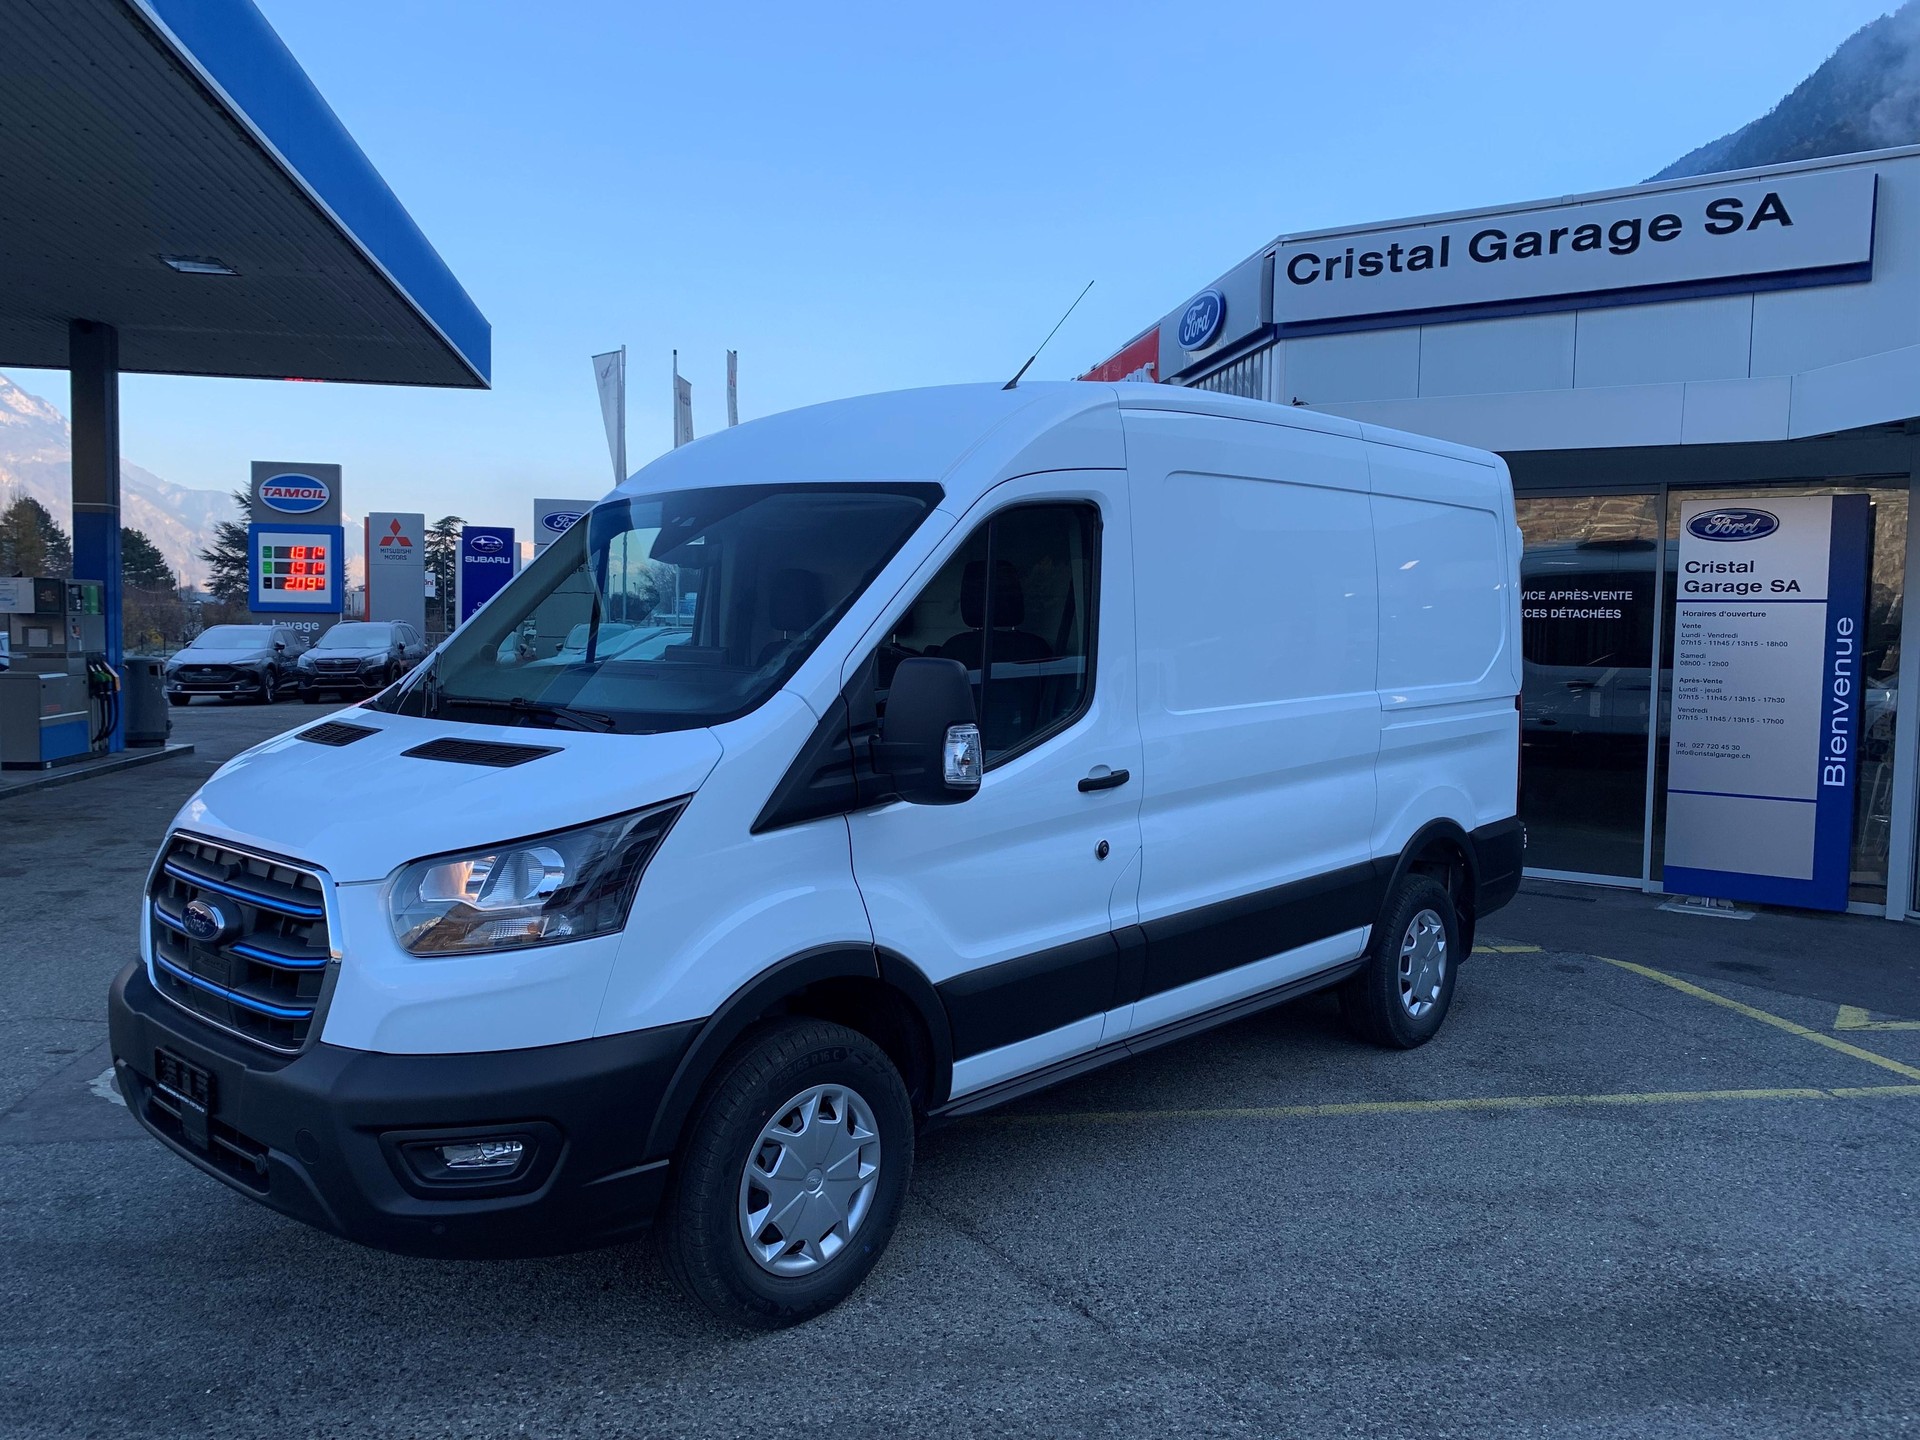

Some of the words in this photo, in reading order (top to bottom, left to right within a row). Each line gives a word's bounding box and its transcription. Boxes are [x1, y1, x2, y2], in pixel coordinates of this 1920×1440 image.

[1286, 235, 1450, 286] Cristal
[1468, 213, 1683, 263] Garage
[1705, 192, 1794, 235] SA
[1183, 301, 1211, 342] Ford
[262, 487, 326, 499] TAMOIL
[1704, 514, 1761, 535] Ford
[465, 555, 511, 564] SUBARU
[1685, 560, 1754, 574] Cristal
[1684, 580, 1762, 595] Garage
[1770, 579, 1801, 593] SA
[1548, 588, 1633, 601] APRÈS-VENTE
[1550, 607, 1622, 619] DÉTACHÉES
[1718, 610, 1767, 618] d'ouverture
[1823, 617, 1854, 787] Bienvenue
[1675, 749, 1751, 760] info@cristalgarage.ch
